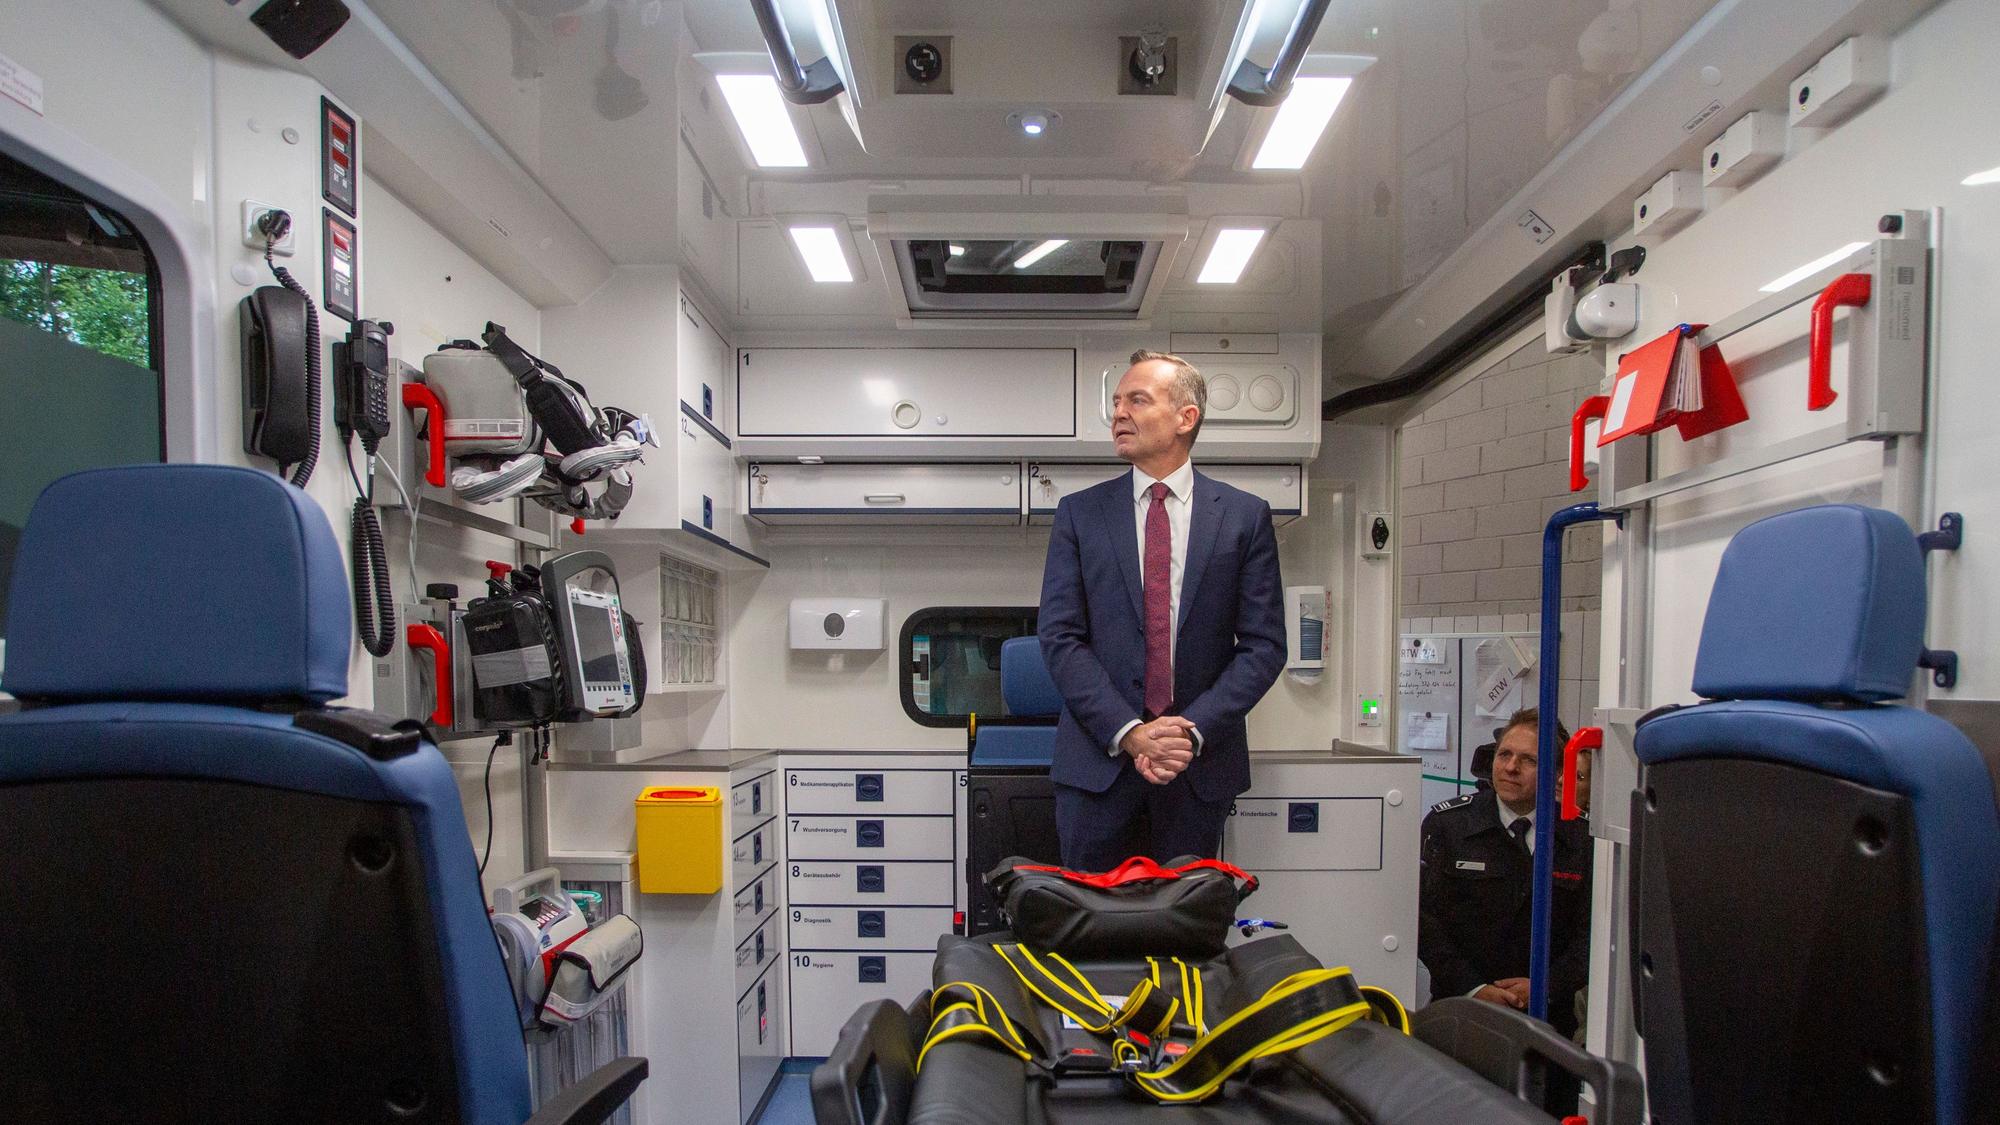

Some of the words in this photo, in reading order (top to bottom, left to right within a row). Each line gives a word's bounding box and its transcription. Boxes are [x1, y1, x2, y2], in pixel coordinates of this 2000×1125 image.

[681, 298, 687, 315] 11
[743, 353, 750, 366] 1
[681, 418, 688, 434] 12
[752, 466, 760, 478] 2
[1031, 466, 1039, 478] 2
[1488, 677, 1508, 701] RTW
[790, 774, 797, 787] 6
[960, 775, 968, 787] 5
[791, 820, 800, 832] 7
[792, 865, 800, 878] 8
[793, 910, 801, 923] 9
[794, 955, 810, 968] 10
